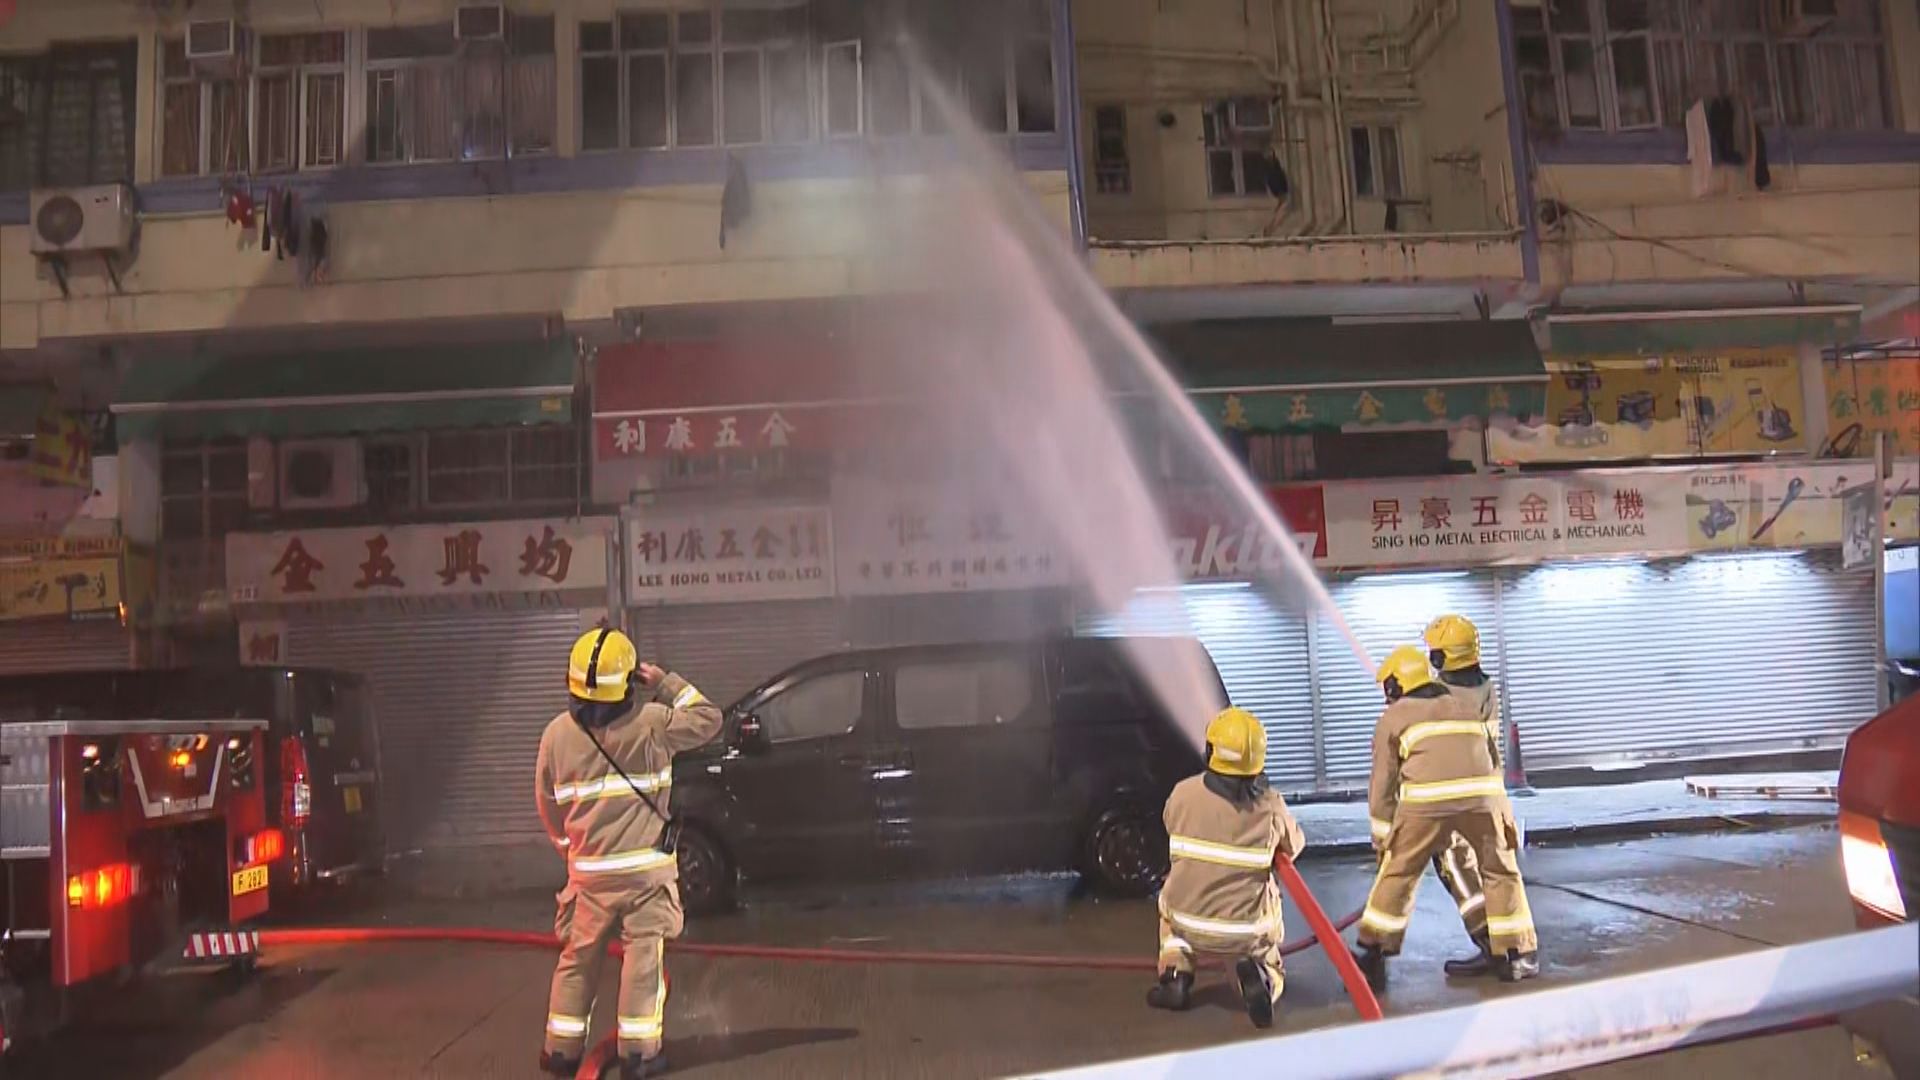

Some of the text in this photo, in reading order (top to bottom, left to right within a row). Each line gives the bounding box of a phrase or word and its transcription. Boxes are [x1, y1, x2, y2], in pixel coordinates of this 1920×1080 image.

[613, 411, 797, 454] 利康五金
[1371, 488, 1645, 532] 昇豪五金電機
[1371, 524, 1646, 549] SING HO METAL ELECTRICAL & MECHANICAL
[638, 574, 663, 587] LEE
[671, 571, 710, 586] HONG
[716, 569, 762, 584] METAL
